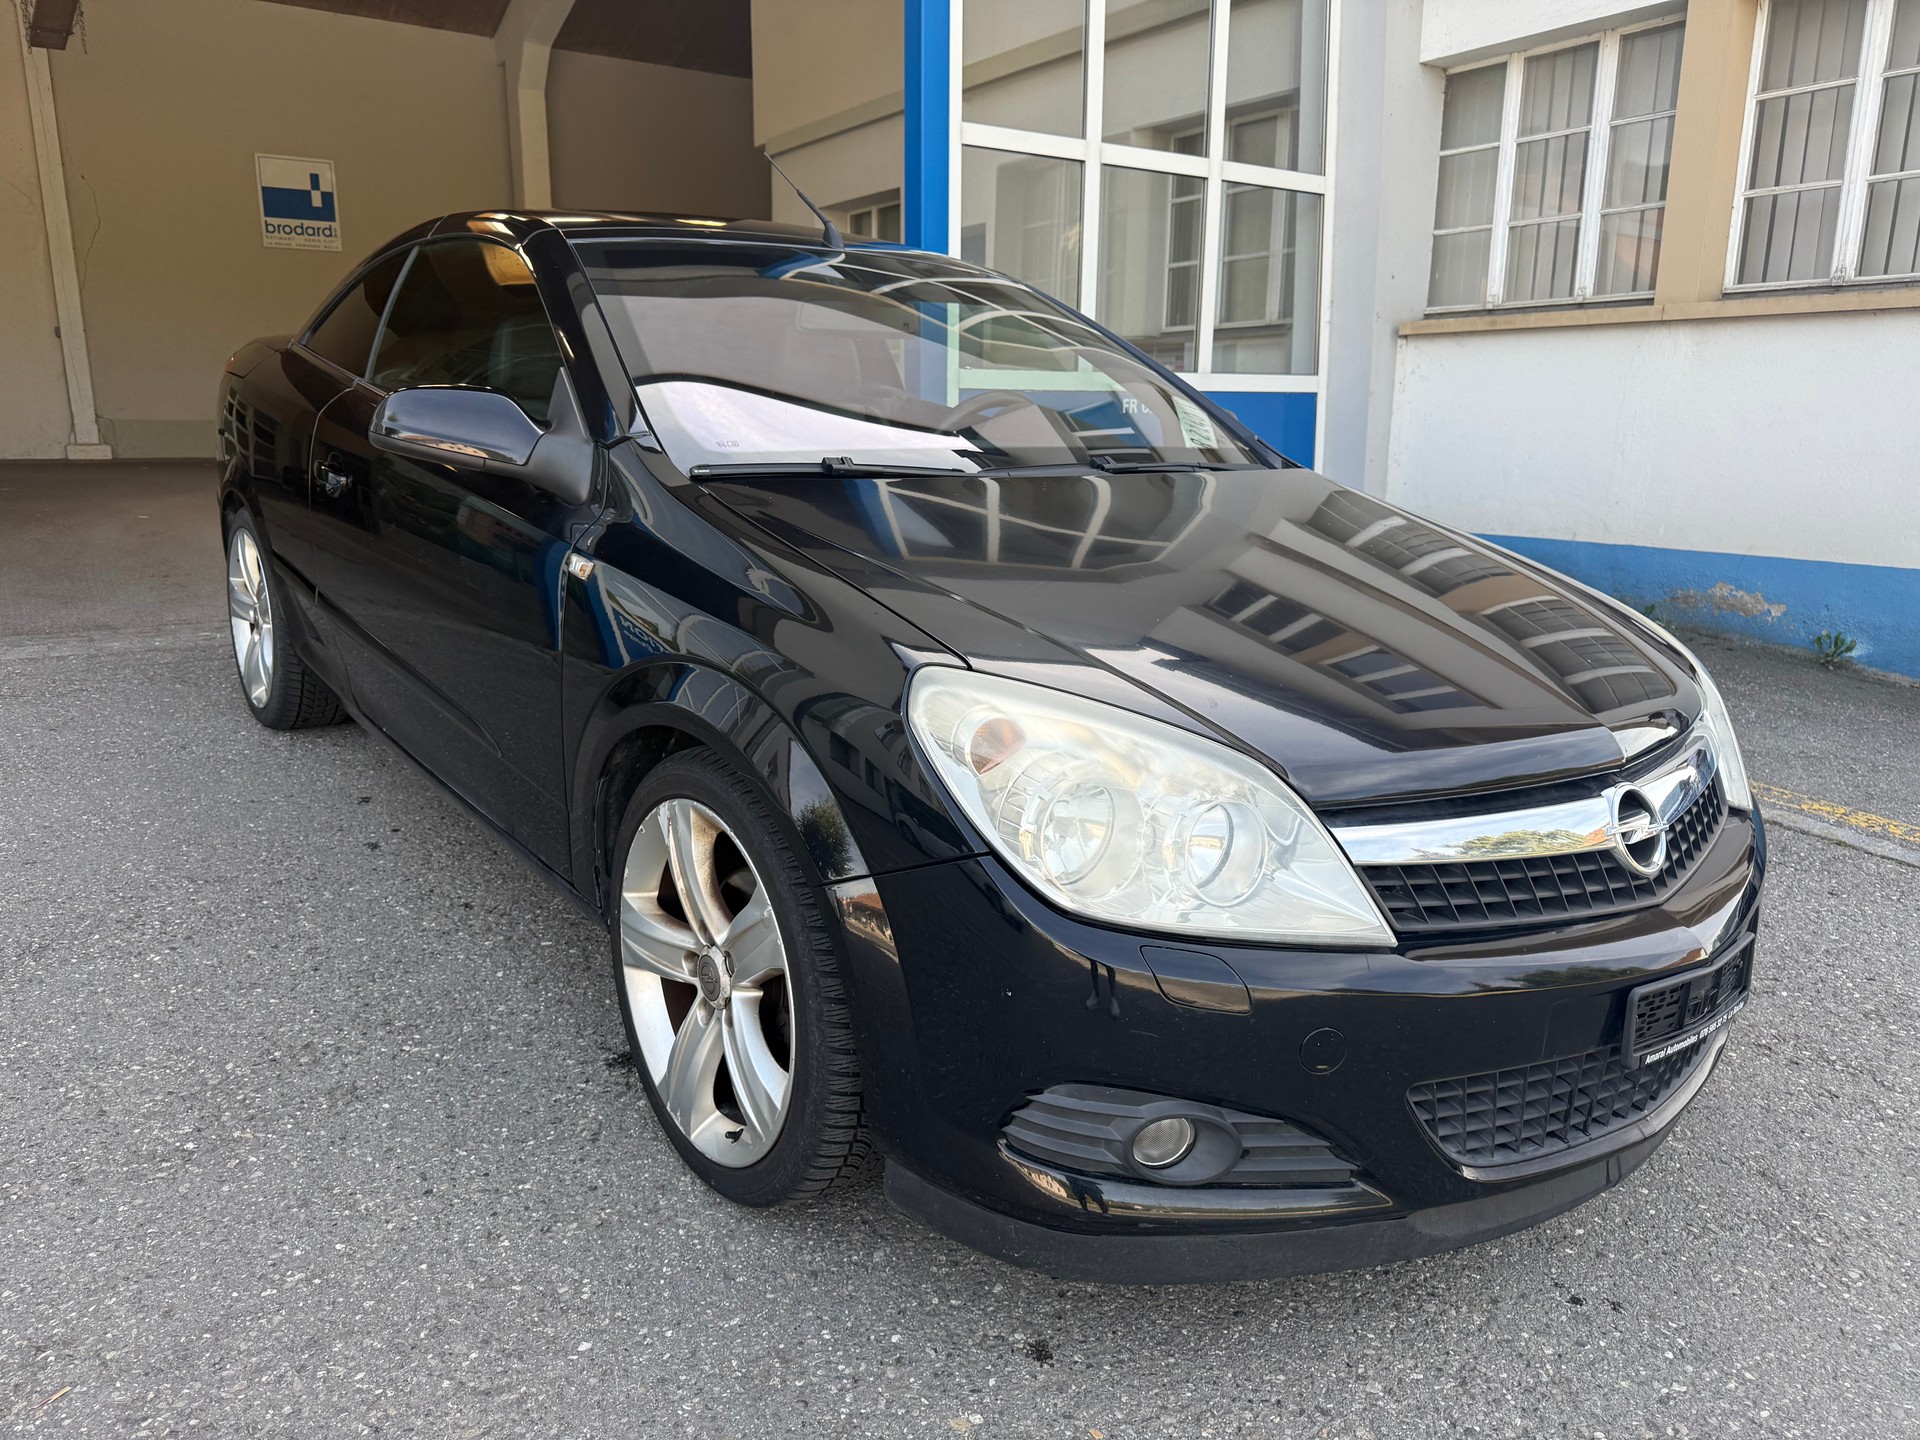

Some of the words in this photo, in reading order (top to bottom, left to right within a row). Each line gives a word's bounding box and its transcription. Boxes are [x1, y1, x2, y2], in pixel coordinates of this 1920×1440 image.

[265, 220, 333, 238] brodard
[1122, 398, 1138, 414] FR
[1645, 1048, 1667, 1065] Amaral
[1665, 1034, 1699, 1056] Automobiles
